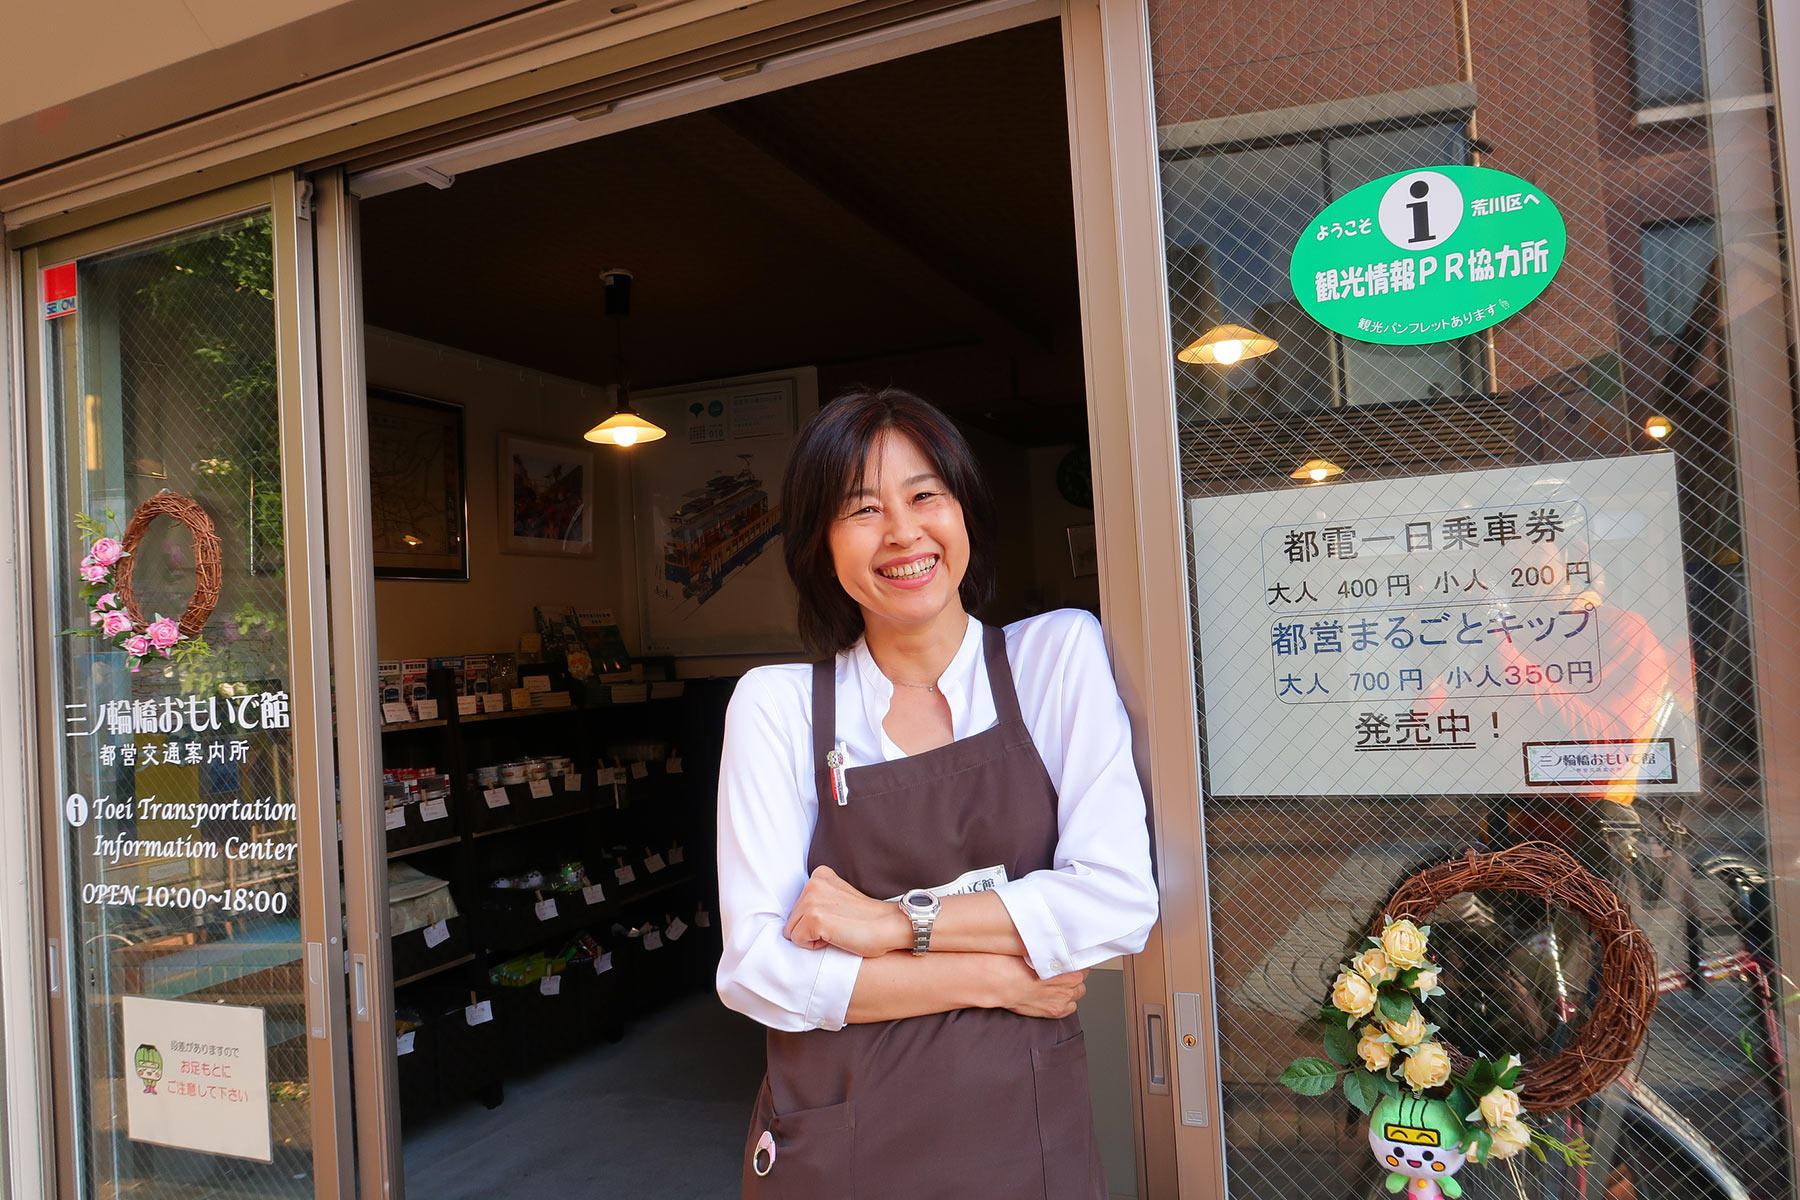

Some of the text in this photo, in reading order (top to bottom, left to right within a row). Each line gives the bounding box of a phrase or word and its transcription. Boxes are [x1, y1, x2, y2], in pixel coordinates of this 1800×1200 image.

[1316, 193, 1540, 241] ようこそ 荒川区へ
[1315, 239, 1549, 302] 観光情報PR協力所
[1357, 303, 1497, 335] 観光パンフレットあります
[1283, 508, 1565, 563] 都電一日乗車券
[1268, 581, 1318, 605] 大人
[1434, 569, 1488, 593] 小人
[1272, 602, 1595, 656] 都営まるごとキップ
[1279, 672, 1329, 696] 大人
[65, 691, 290, 737] 三ノ輪橋おもいで館
[99, 739, 249, 767] 都営交通案内所
[92, 795, 133, 820] Toei
[137, 795, 297, 828] Transportation
[93, 832, 299, 864] Information Center
[82, 883, 139, 906] OPEN
[181, 1060, 231, 1078] お足もとに
